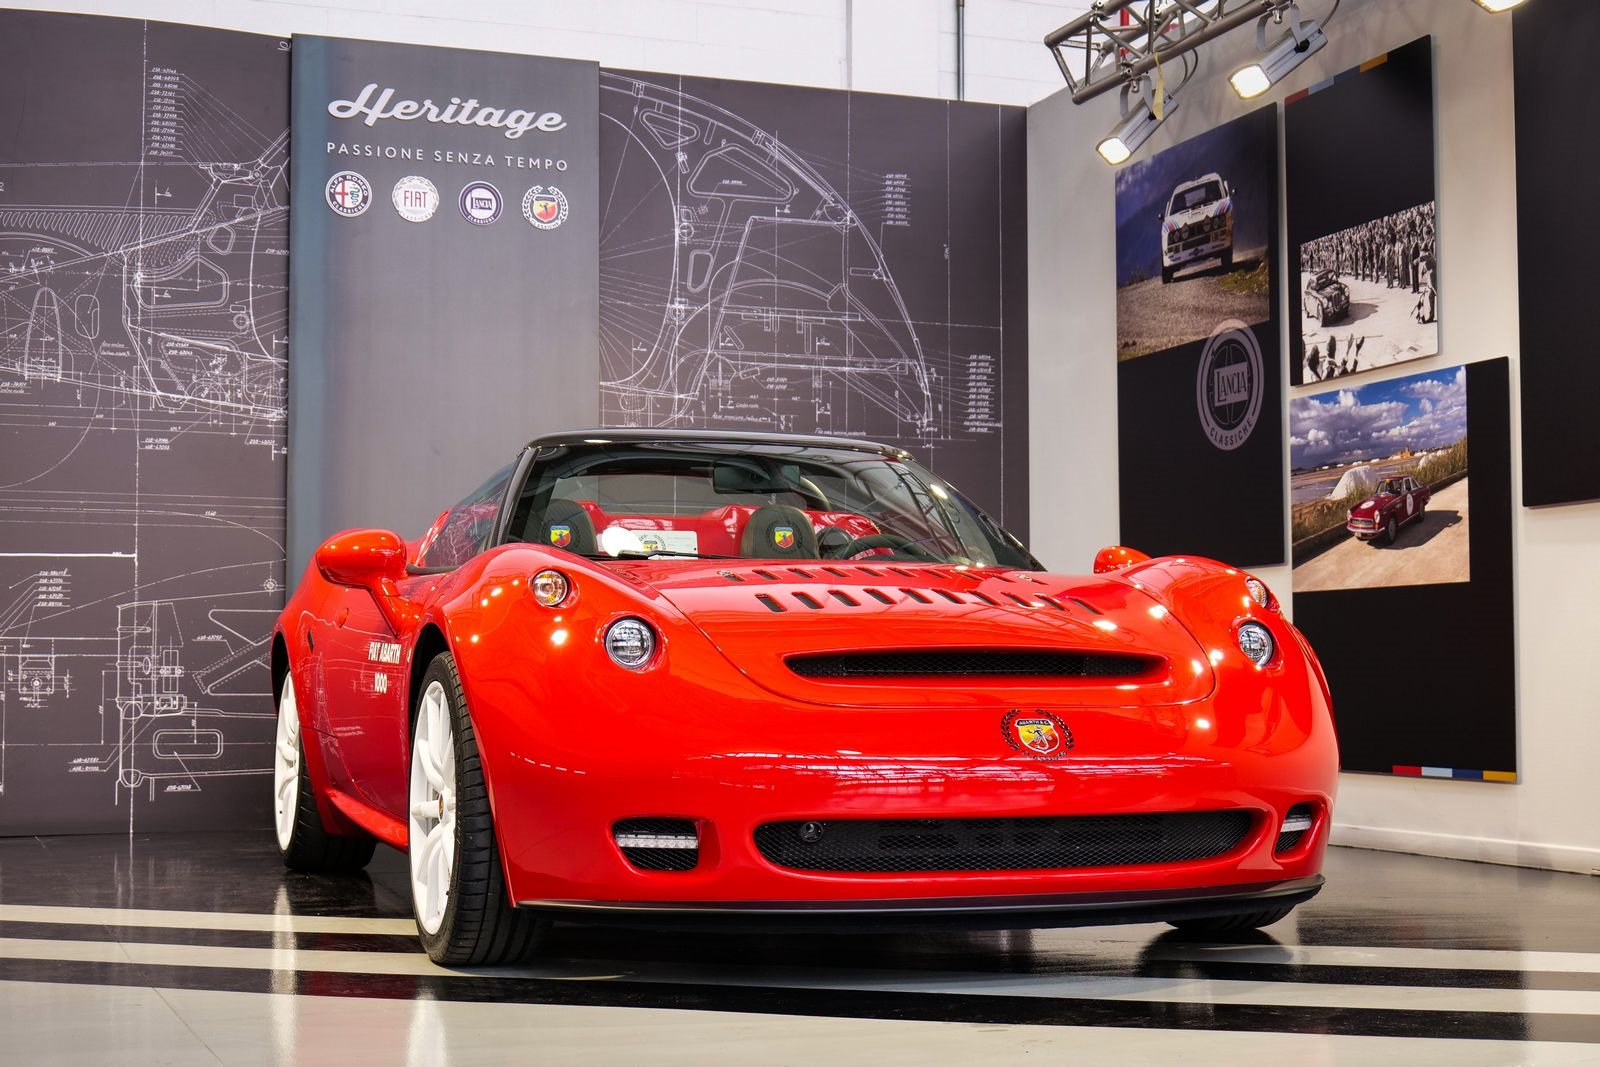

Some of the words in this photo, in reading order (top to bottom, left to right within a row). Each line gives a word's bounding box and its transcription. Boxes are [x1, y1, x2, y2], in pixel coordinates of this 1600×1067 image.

[327, 83, 567, 139] Heritage
[327, 142, 424, 161] PASSIONE
[434, 150, 495, 166] SENZA
[505, 155, 568, 171] TEMPO
[329, 176, 344, 193] ALFA
[346, 175, 369, 196] ROMEO
[332, 200, 366, 214] CLASSICHE
[404, 190, 428, 208] FIAT
[472, 197, 493, 210] LANCIA
[467, 214, 496, 224] CLASSICHE
[1217, 371, 1247, 402] LANCIA
[1210, 419, 1252, 446] CLASSICHE
[368, 641, 381, 661] FIAT
[379, 643, 401, 664] ABARTH
